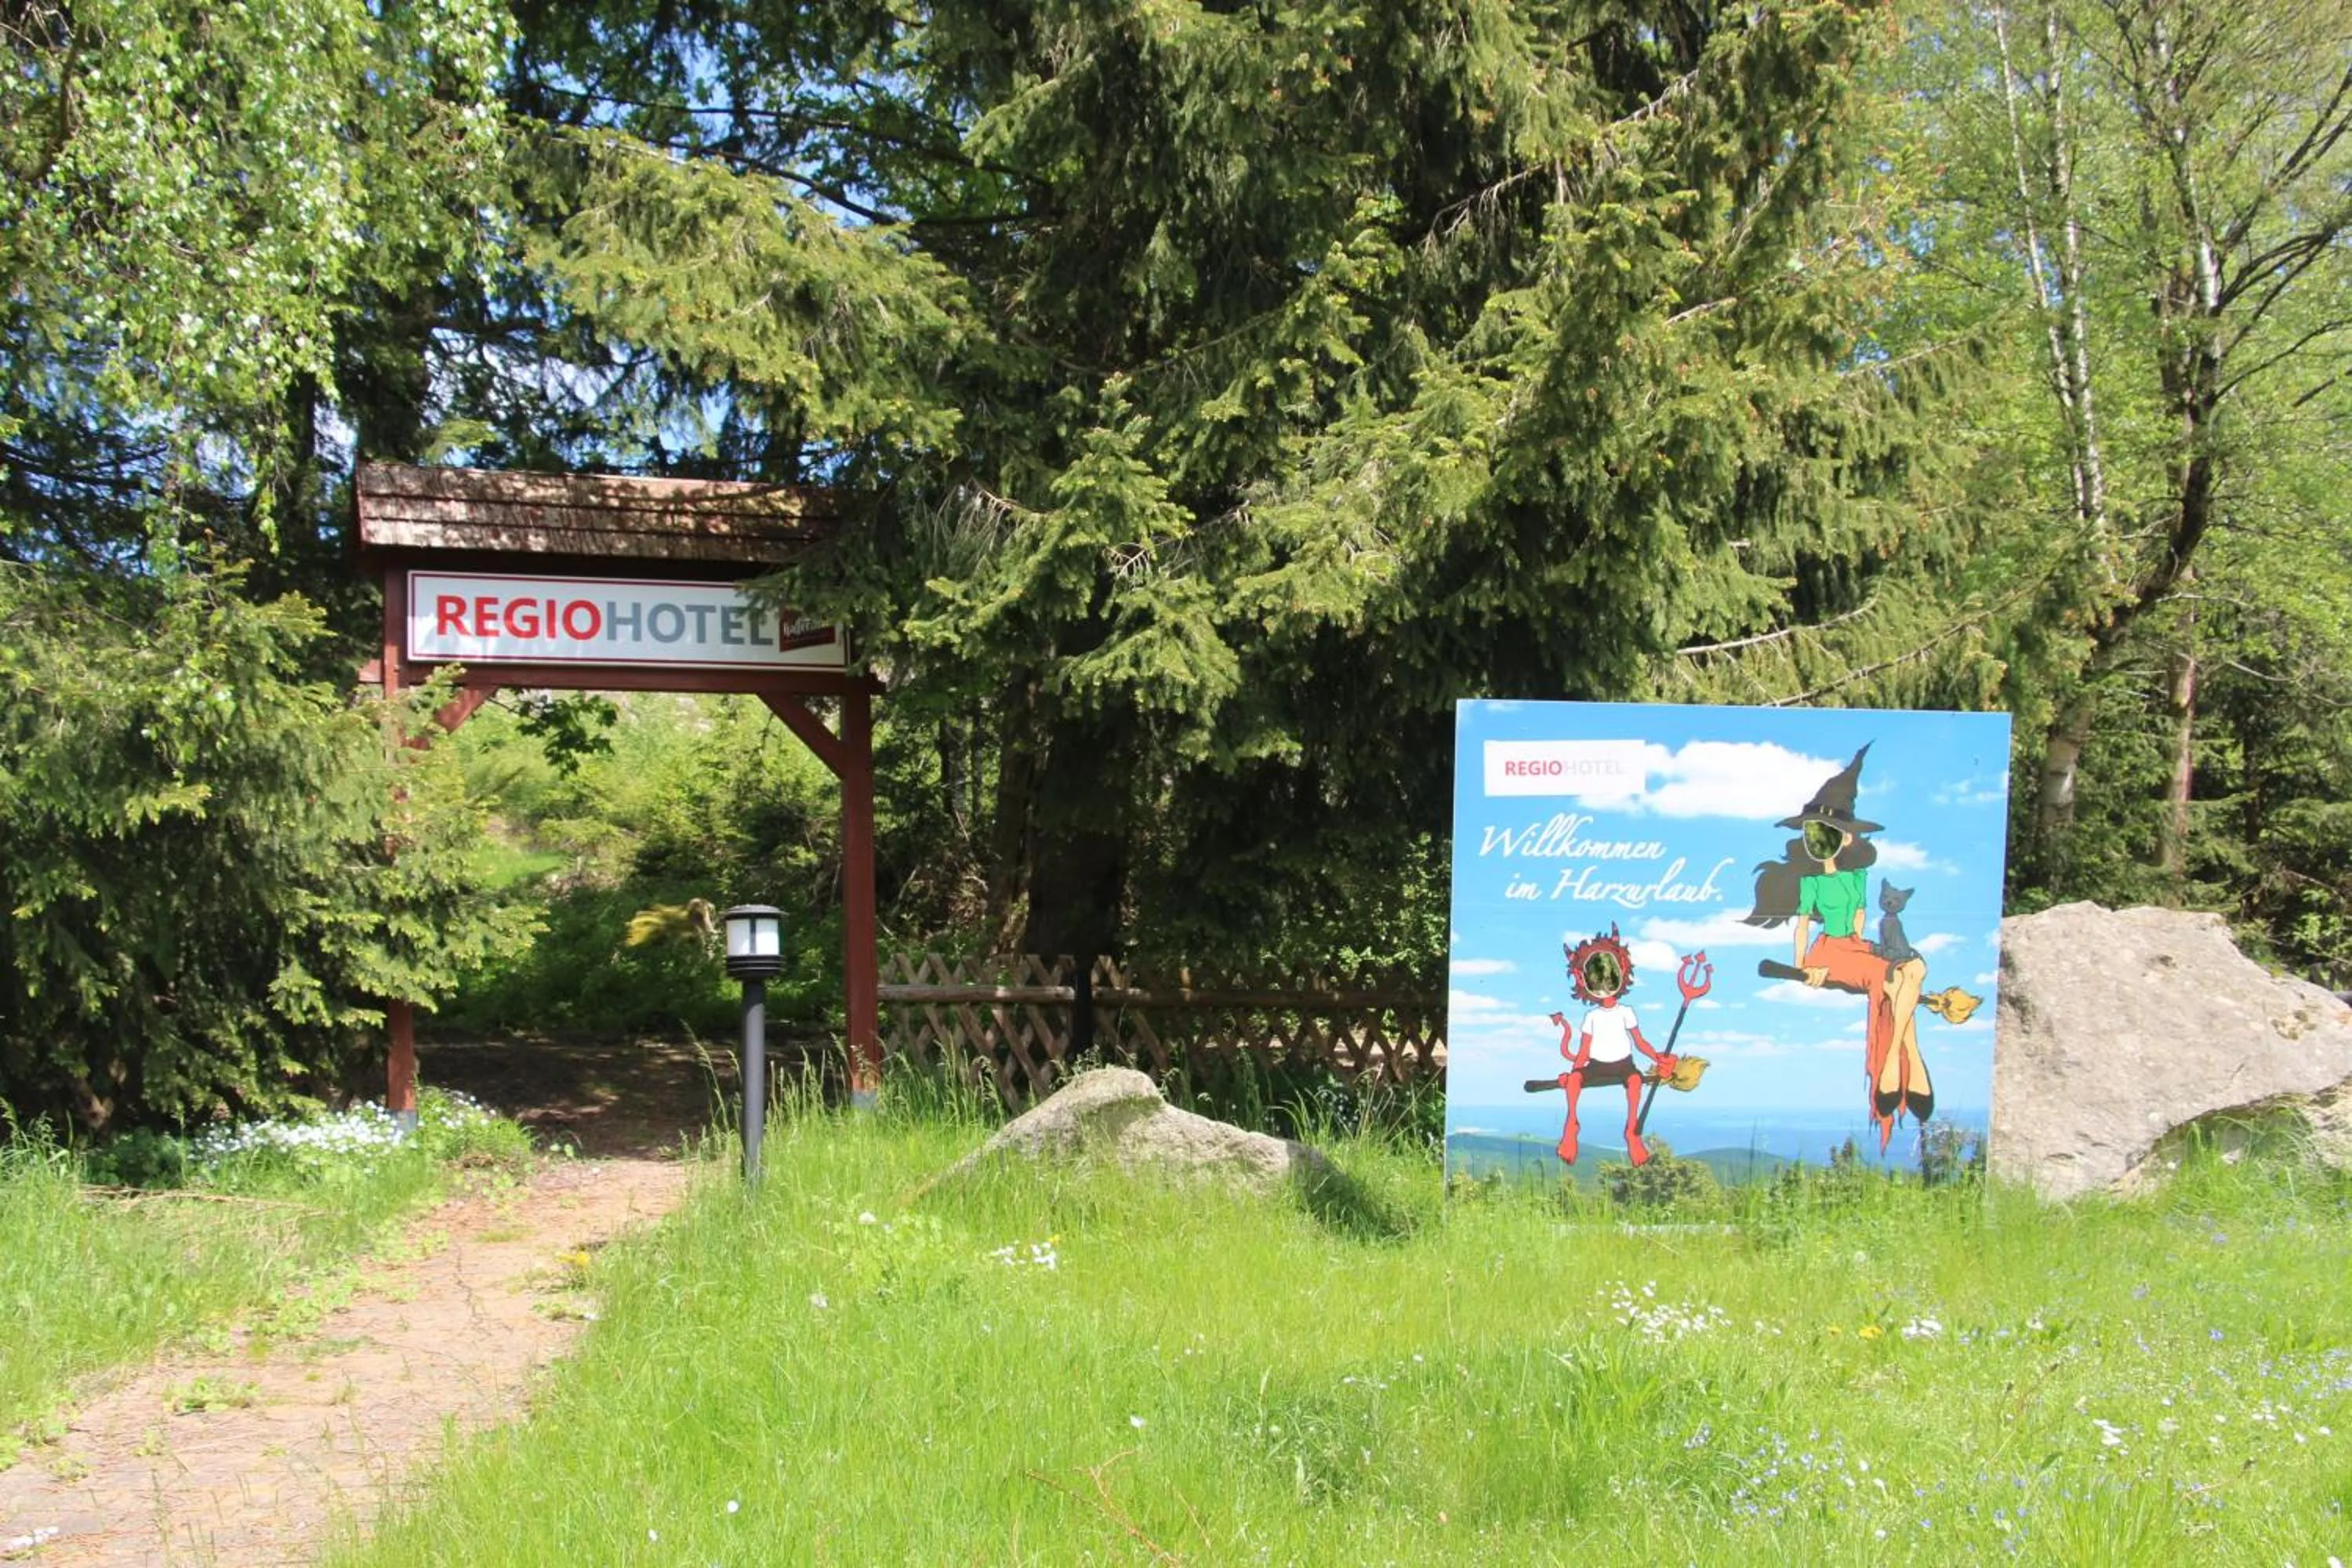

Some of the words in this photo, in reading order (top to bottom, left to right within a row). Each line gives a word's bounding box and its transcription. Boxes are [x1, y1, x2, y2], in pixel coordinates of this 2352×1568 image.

[437, 594, 774, 646] REGIOHOTEL
[1504, 760, 1625, 776] REGIOHOTEL
[1479, 812, 1668, 859] Willkommen
[1504, 872, 1543, 902] im
[1549, 856, 1735, 909] Harzurlaub.
